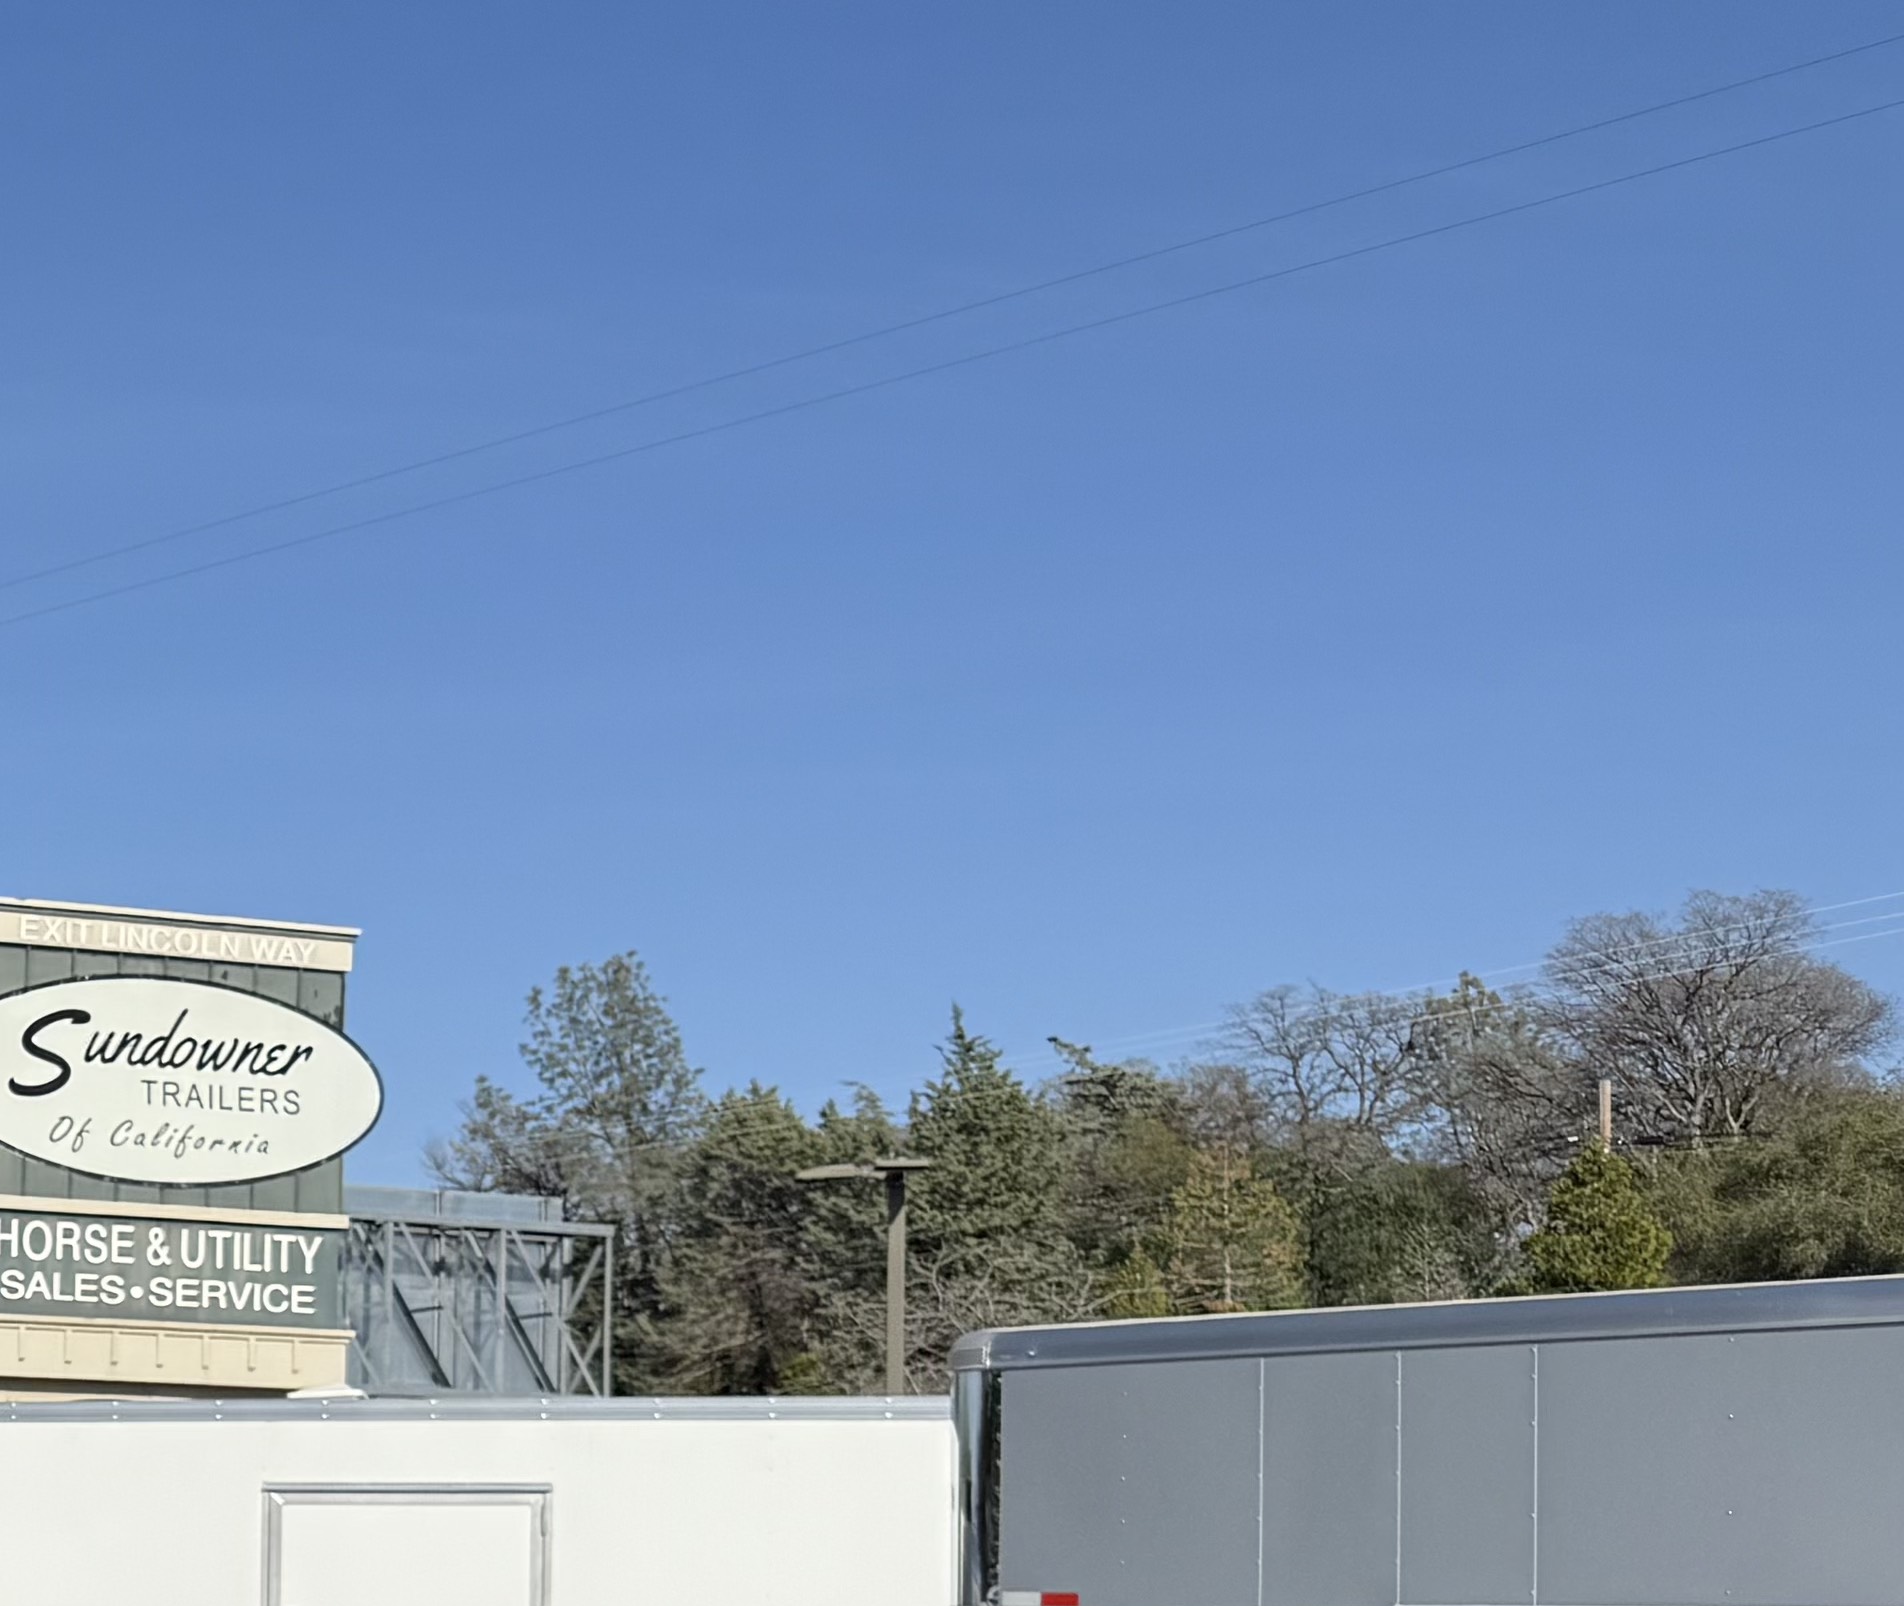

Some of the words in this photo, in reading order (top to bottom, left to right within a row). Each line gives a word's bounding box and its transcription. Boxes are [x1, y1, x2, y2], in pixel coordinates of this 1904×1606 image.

[19, 914, 92, 945] EXIT
[101, 921, 240, 959] LINCOLN
[245, 937, 317, 964] WAY
[8, 1008, 313, 1097] Sundowner
[141, 1079, 301, 1116] TRAILERS
[49, 1115, 93, 1152] Of
[110, 1119, 271, 1158] California
[146, 1226, 172, 1266] &
[181, 1231, 324, 1275] UTILITY
